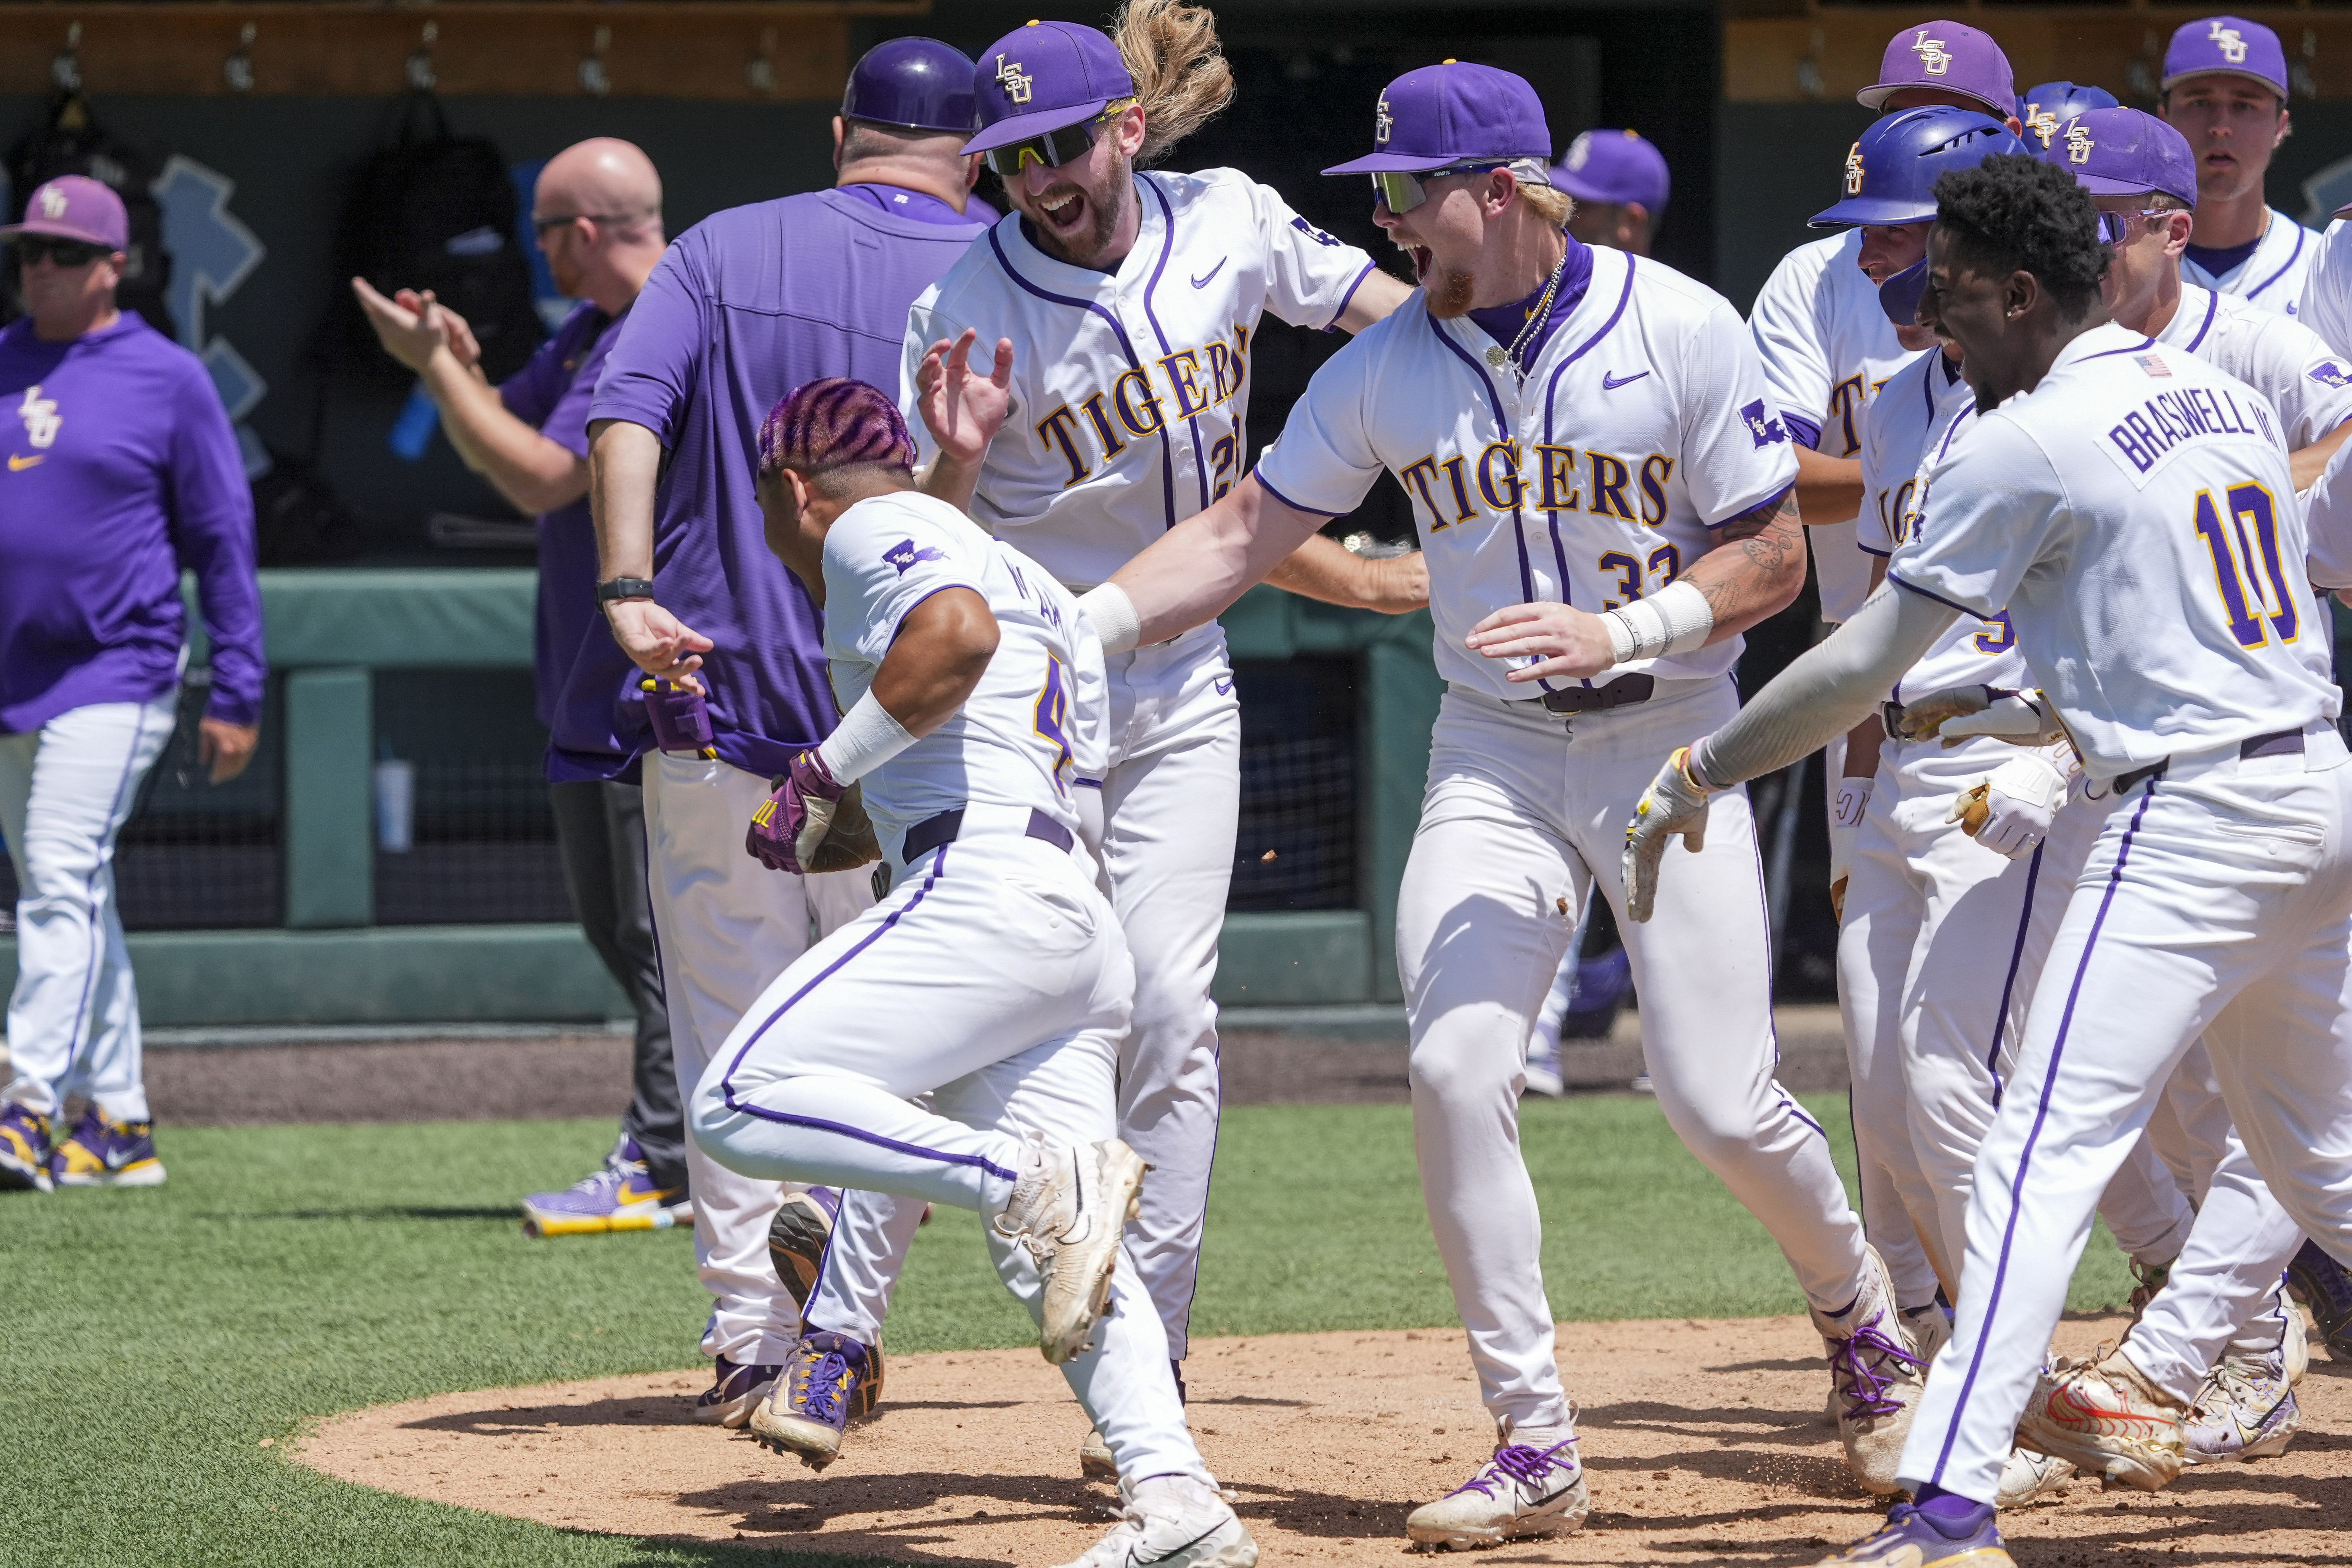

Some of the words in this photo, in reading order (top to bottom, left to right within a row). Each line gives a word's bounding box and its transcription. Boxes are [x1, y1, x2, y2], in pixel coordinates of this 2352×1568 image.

[1912, 30, 1952, 75] LSU
[2208, 21, 2248, 63] LSU
[996, 53, 1032, 104] LSU
[1376, 87, 1393, 144] LSU
[2063, 116, 2095, 165] LSU
[1845, 142, 1865, 195] LSU
[1035, 323, 1250, 488] TIGERS
[1750, 417, 1767, 437] LSU
[2109, 388, 2254, 474] BRASWELL
[1399, 438, 1675, 534] TIGERS
[2194, 480, 2299, 650] 10
